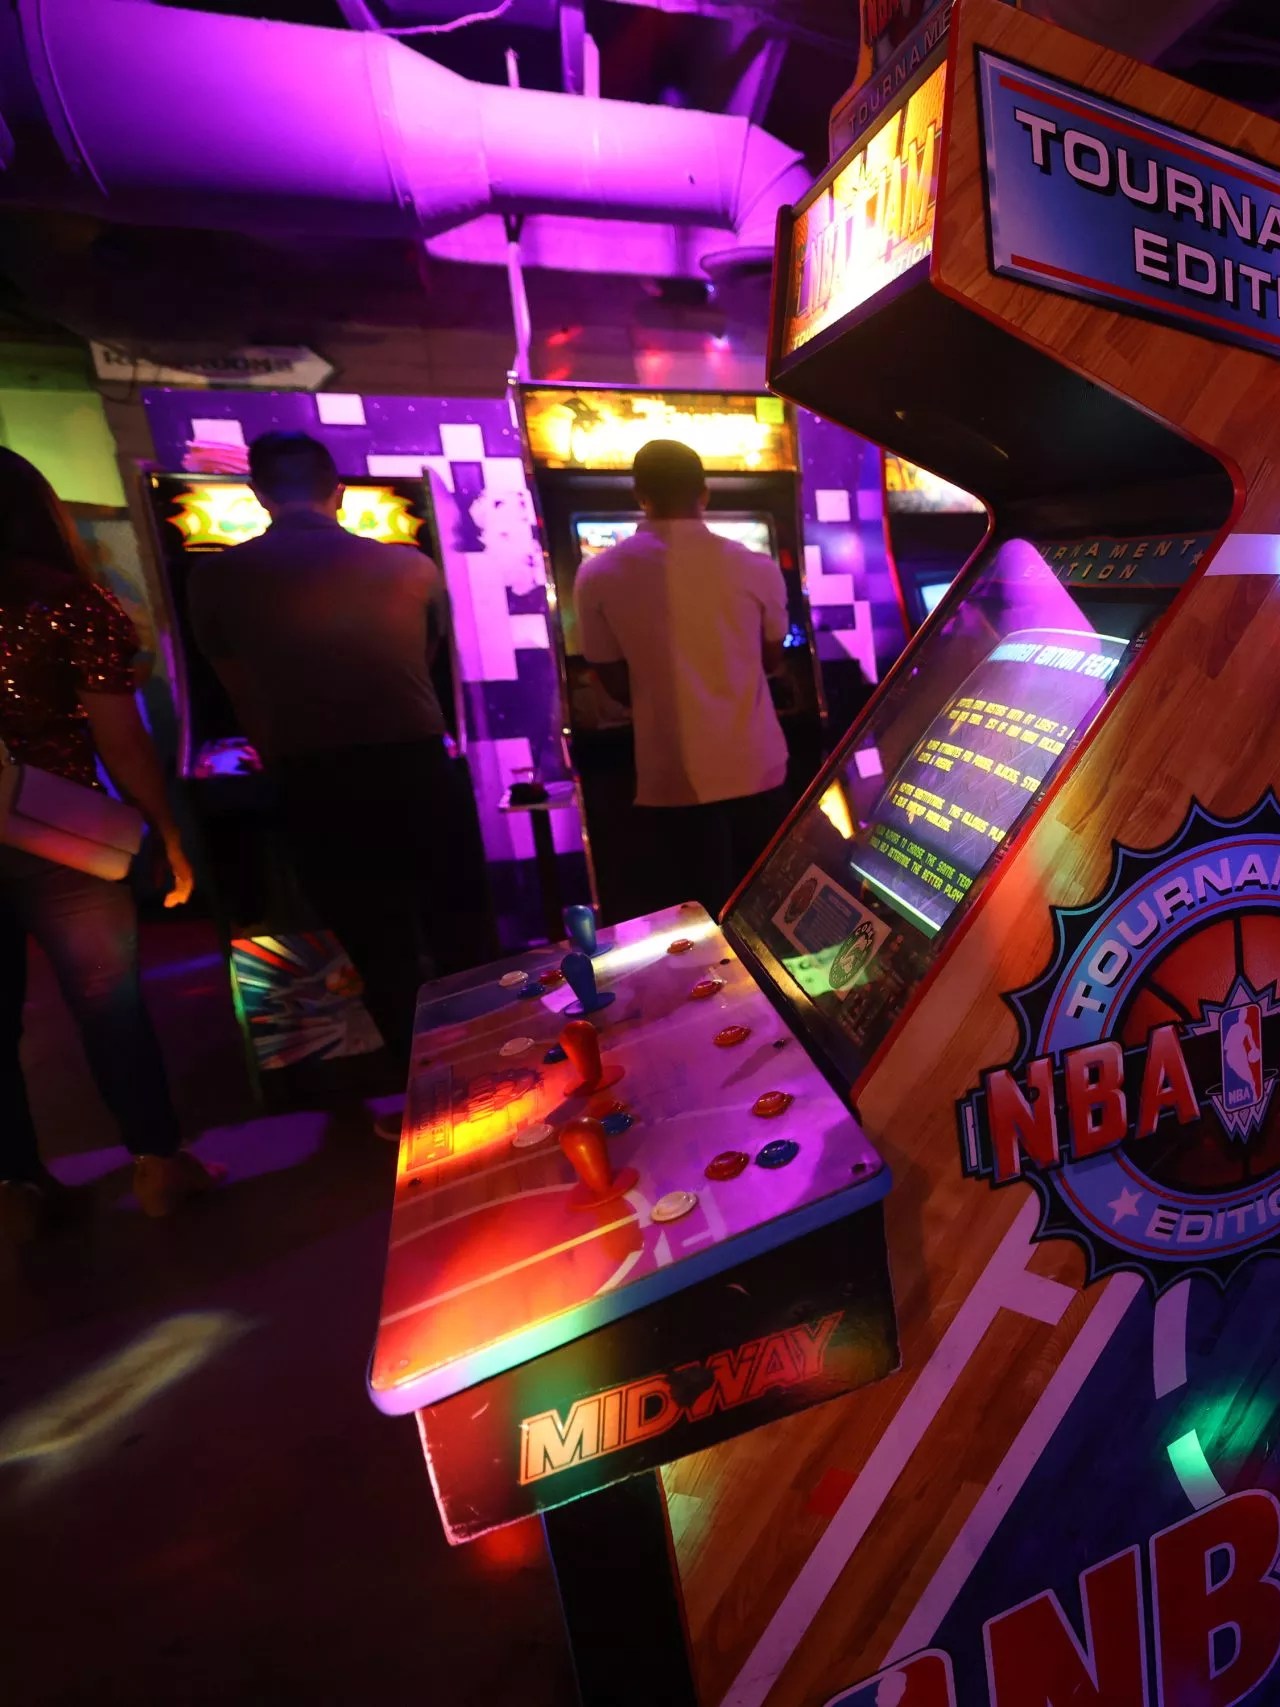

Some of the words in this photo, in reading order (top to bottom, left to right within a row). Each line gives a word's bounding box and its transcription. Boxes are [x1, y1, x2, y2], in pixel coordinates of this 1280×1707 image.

[868, 122, 937, 250] JAM
[985, 1022, 1201, 1185] NBA
[1228, 1086, 1251, 1106] NBA
[519, 1309, 846, 1487] MIDWAY
